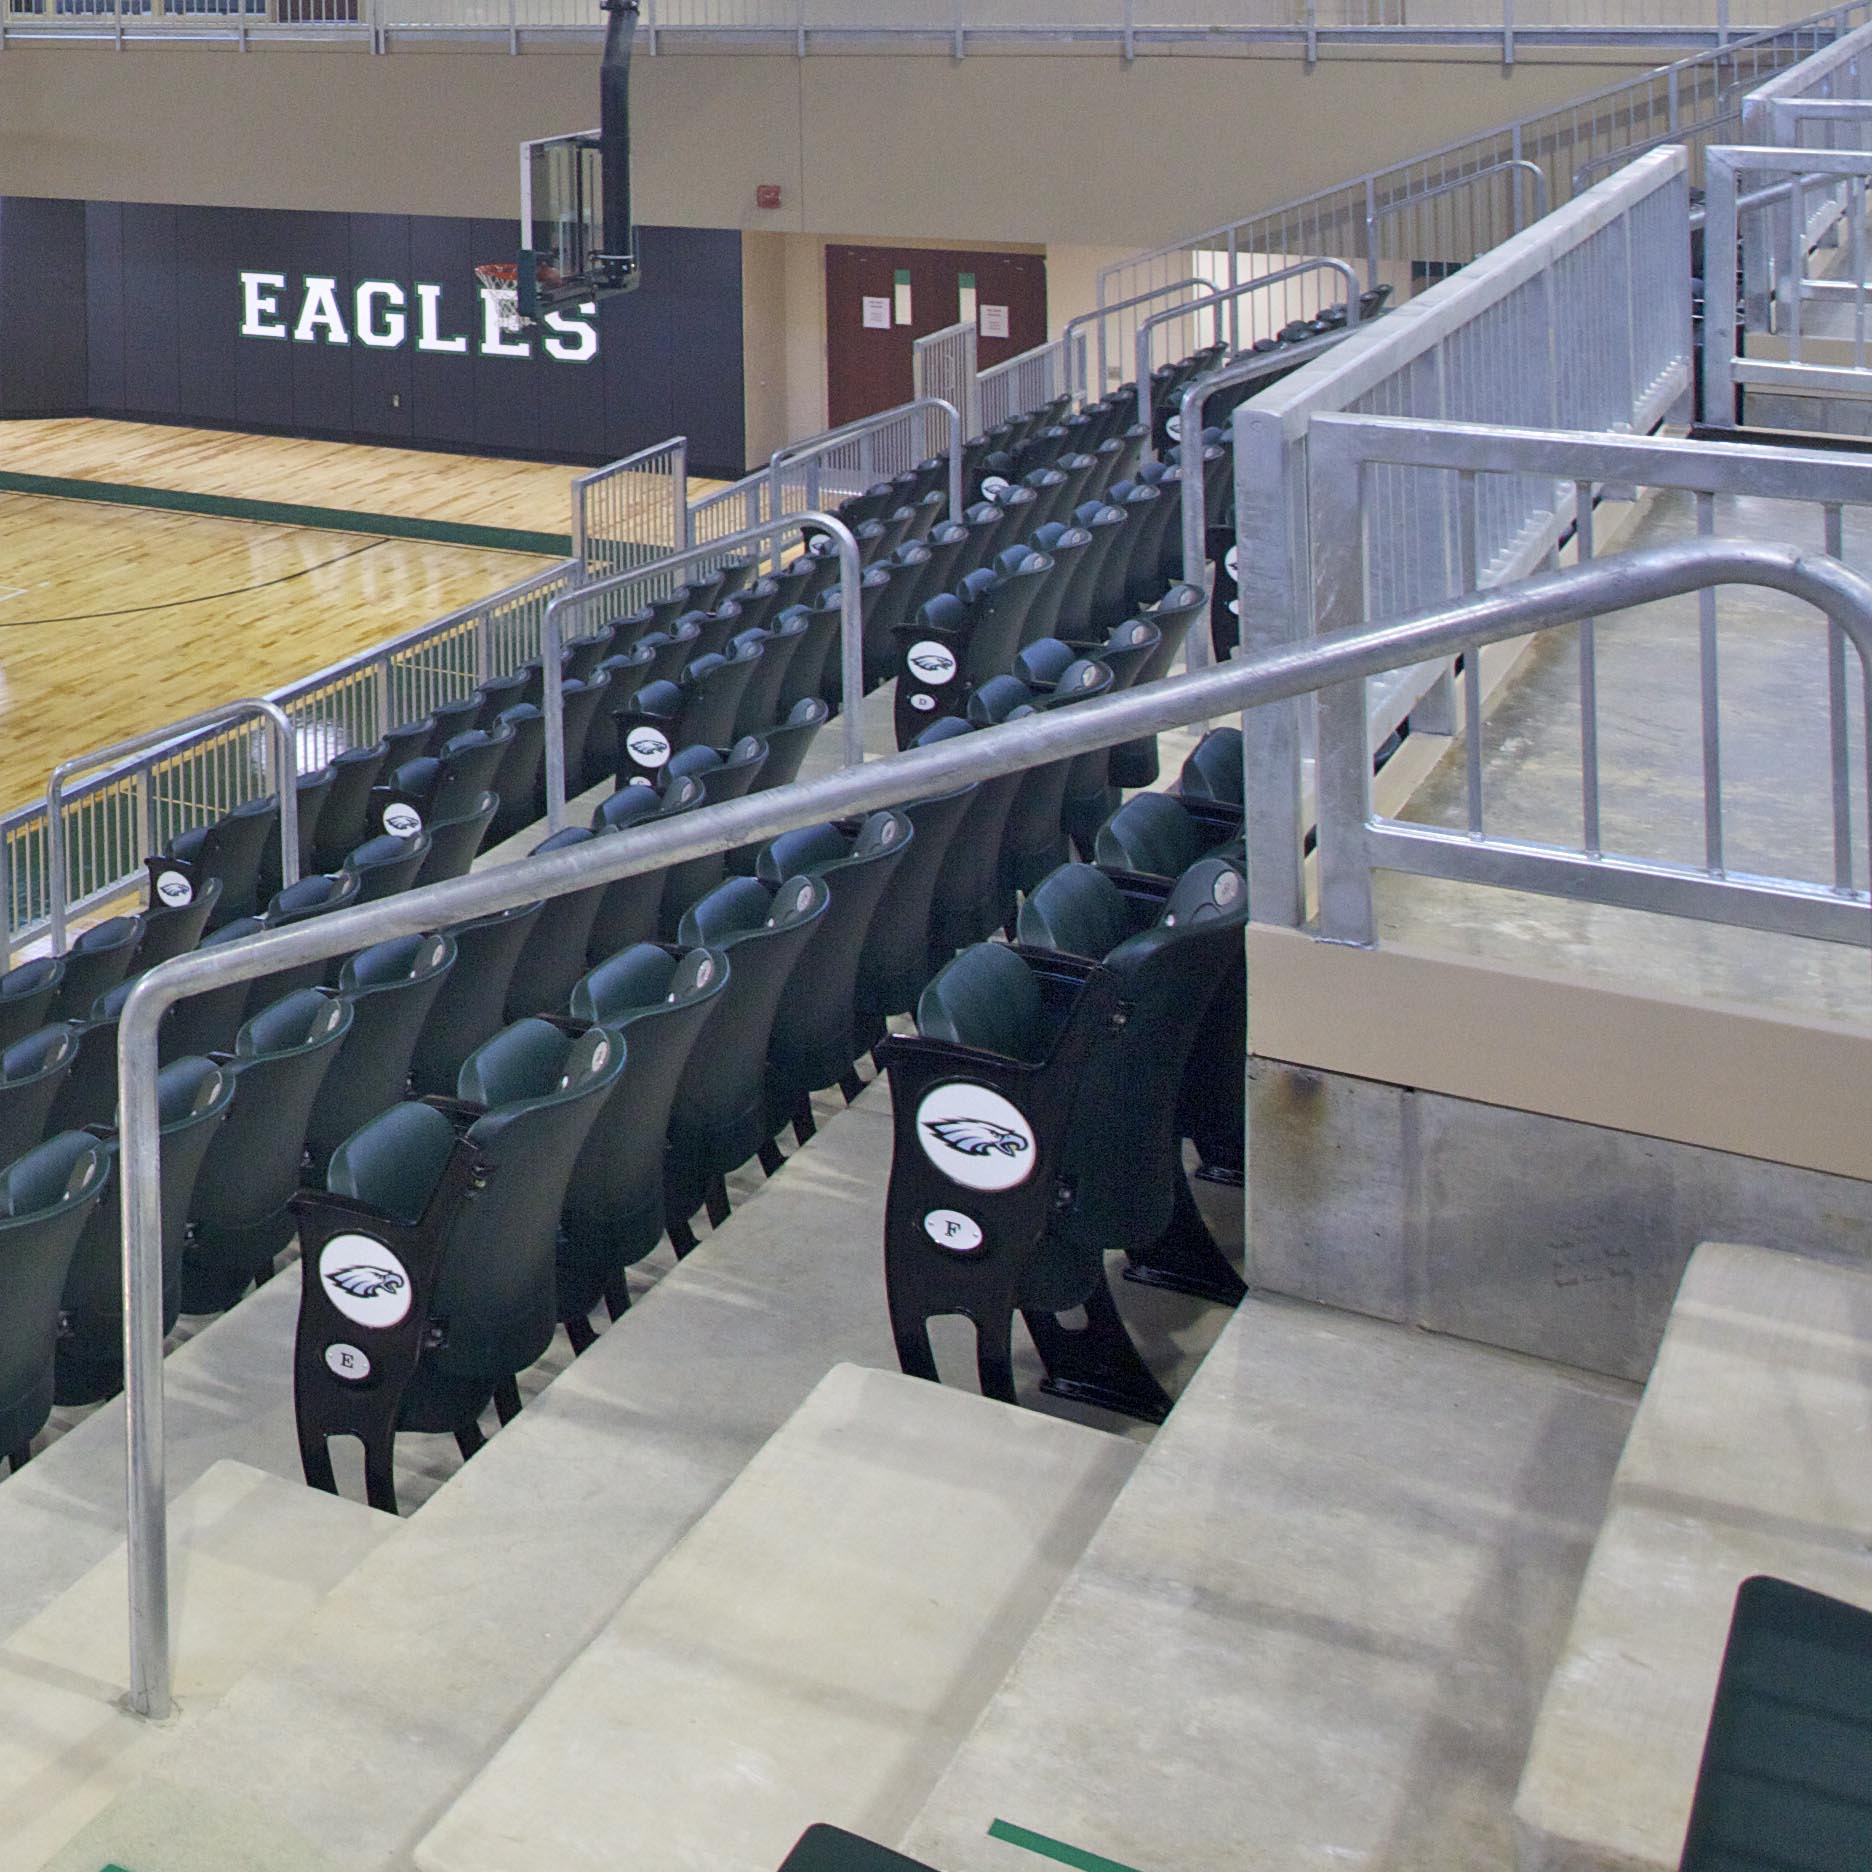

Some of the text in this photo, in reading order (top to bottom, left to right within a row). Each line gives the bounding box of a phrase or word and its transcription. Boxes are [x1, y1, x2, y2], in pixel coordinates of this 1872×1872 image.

[239, 270, 599, 364] EAGLES
[944, 1220, 961, 1237] F
[340, 1352, 354, 1369] E
